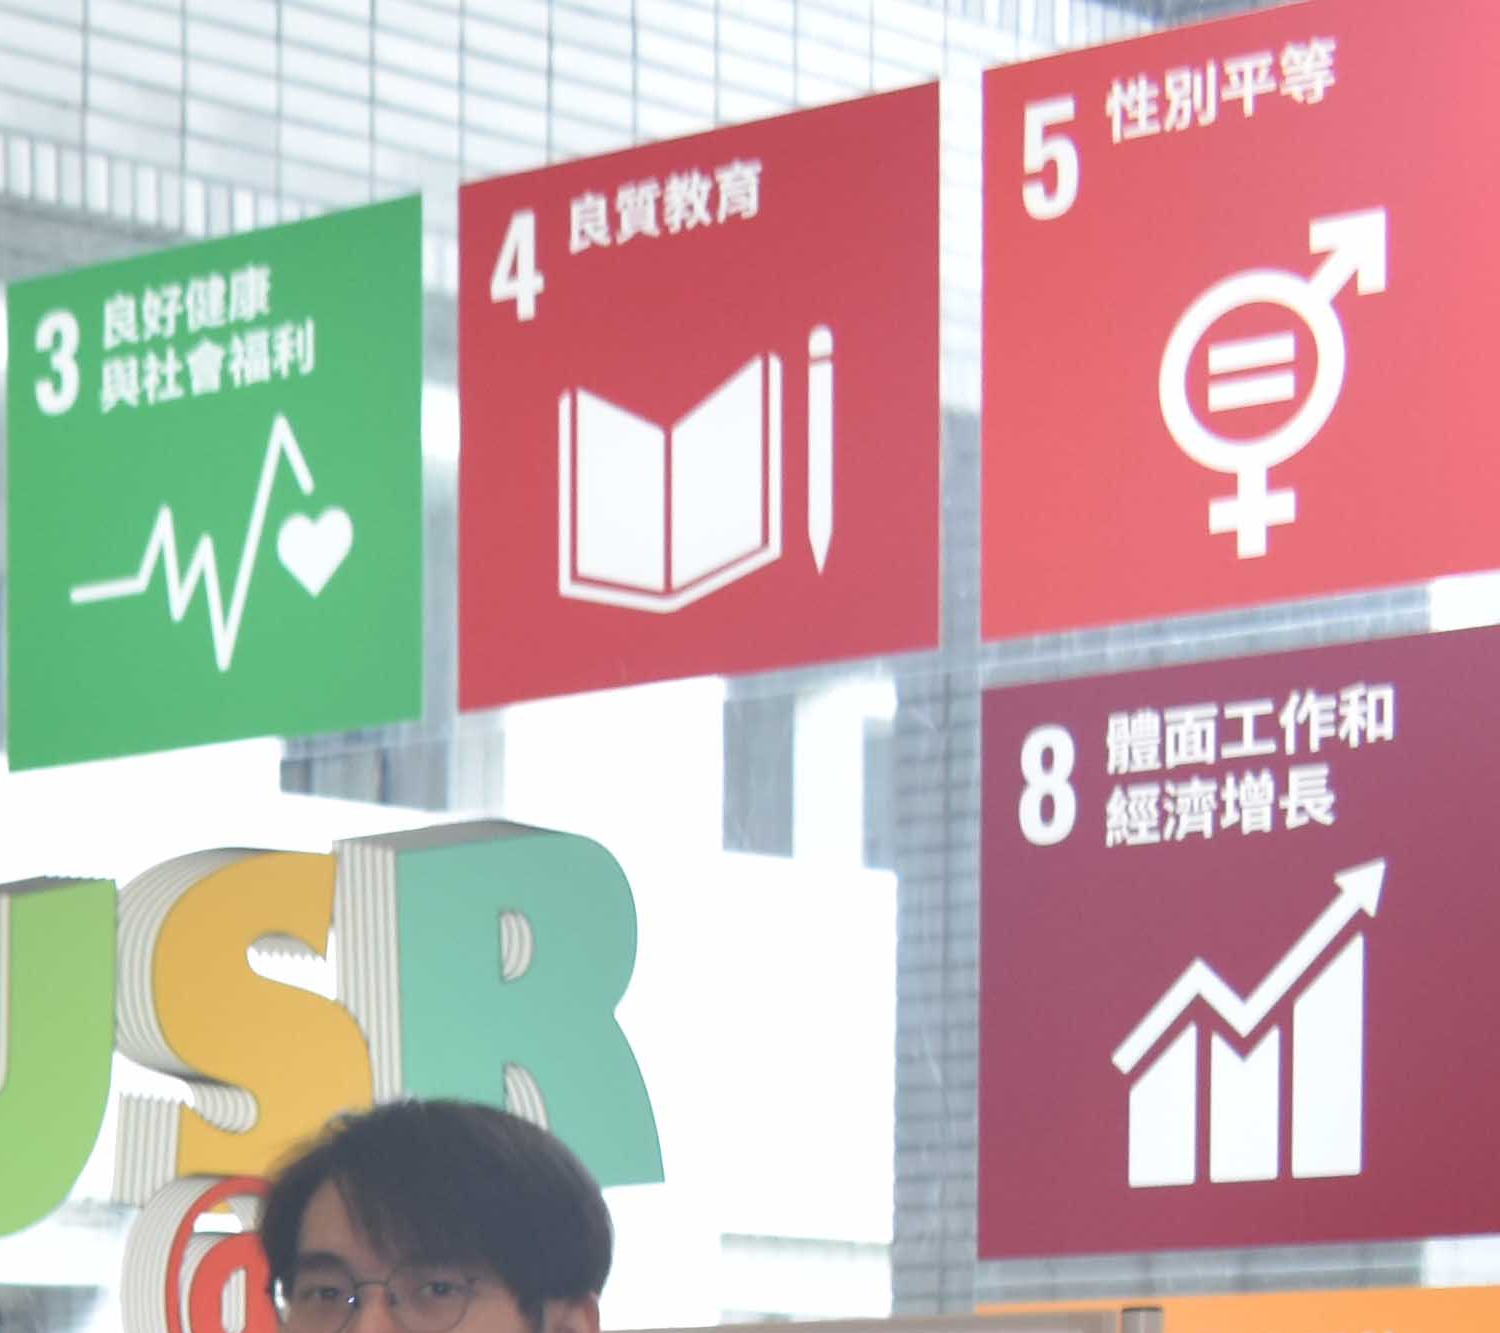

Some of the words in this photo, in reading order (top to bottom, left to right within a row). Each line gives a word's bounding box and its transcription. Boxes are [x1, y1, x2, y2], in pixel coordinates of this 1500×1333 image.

[1104, 36, 1336, 144] 性別平等
[567, 157, 763, 255] 良質教育
[1022, 94, 1080, 221] 5
[100, 264, 272, 346] 良好健康
[489, 209, 544, 323] 4
[33, 311, 81, 415] 3
[99, 317, 316, 415] 與社會福利
[1104, 683, 1397, 774] 體面工作和
[1018, 723, 1077, 846] 8
[1104, 764, 1336, 849] 經濟增長
